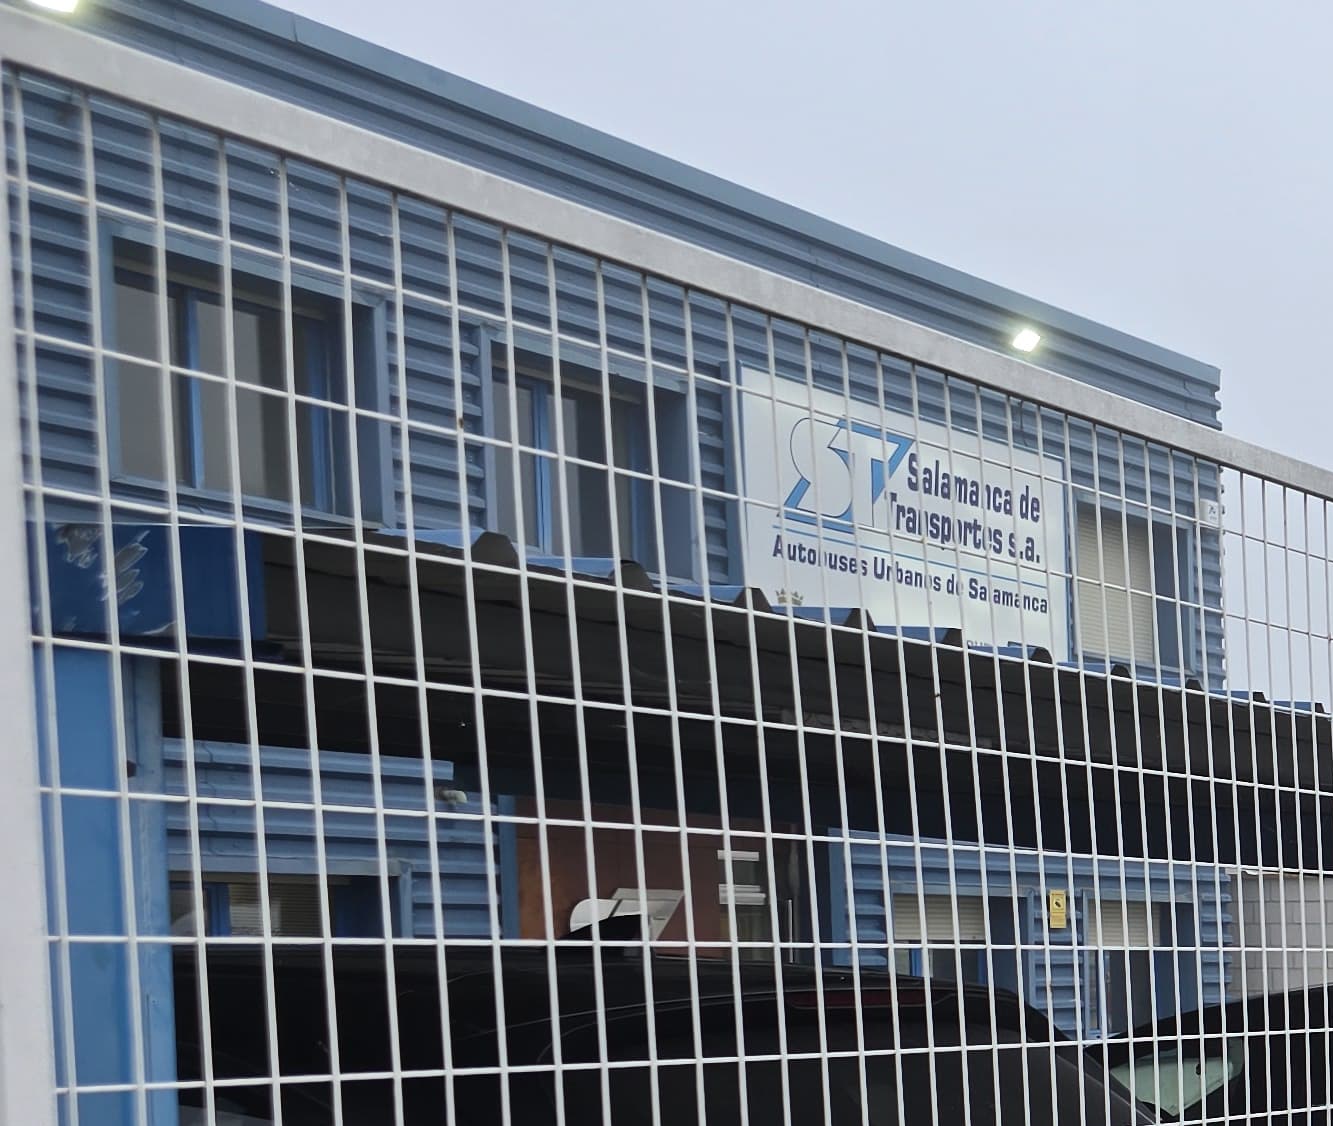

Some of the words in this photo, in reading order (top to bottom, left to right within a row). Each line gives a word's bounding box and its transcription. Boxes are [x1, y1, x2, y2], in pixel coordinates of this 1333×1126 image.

[907, 452, 1013, 516] Salamanca
[1019, 484, 1040, 523] de
[1008, 532, 1040, 564] s.a.
[968, 578, 1048, 614] Saamanca
